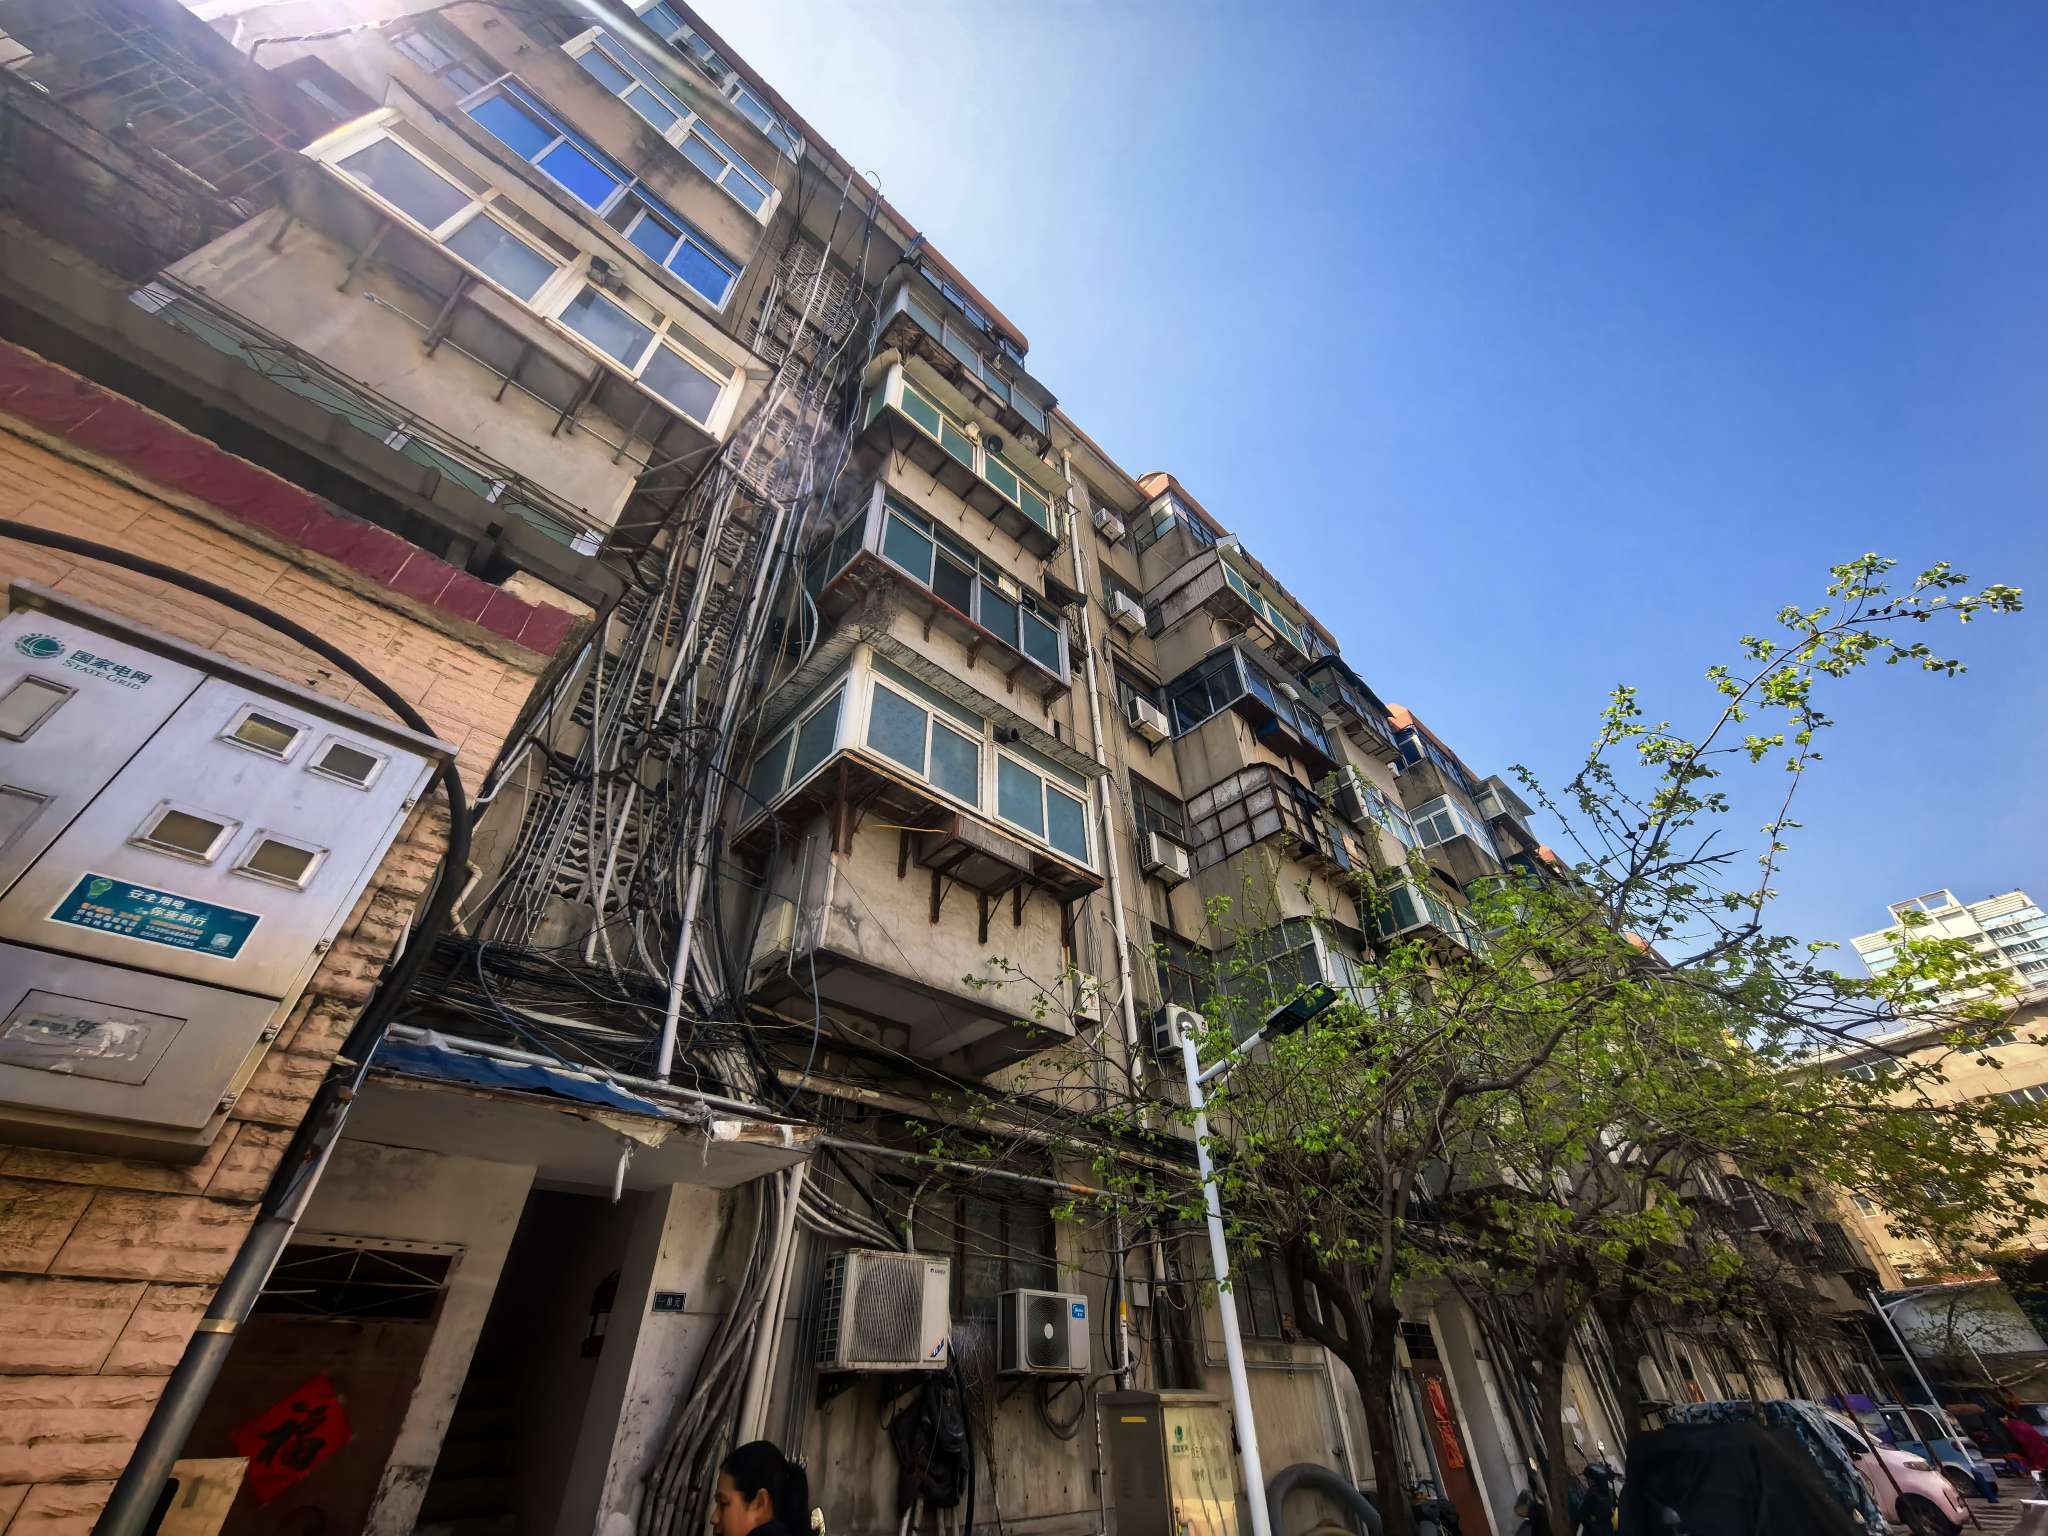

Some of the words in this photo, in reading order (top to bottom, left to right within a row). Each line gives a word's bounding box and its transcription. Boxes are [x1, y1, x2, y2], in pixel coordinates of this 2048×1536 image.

[62, 659, 105, 678] STATE
[105, 674, 142, 690] GRID
[70, 650, 152, 684] 国家电网
[127, 889, 186, 910] 安全用电
[256, 1402, 328, 1470] 福
